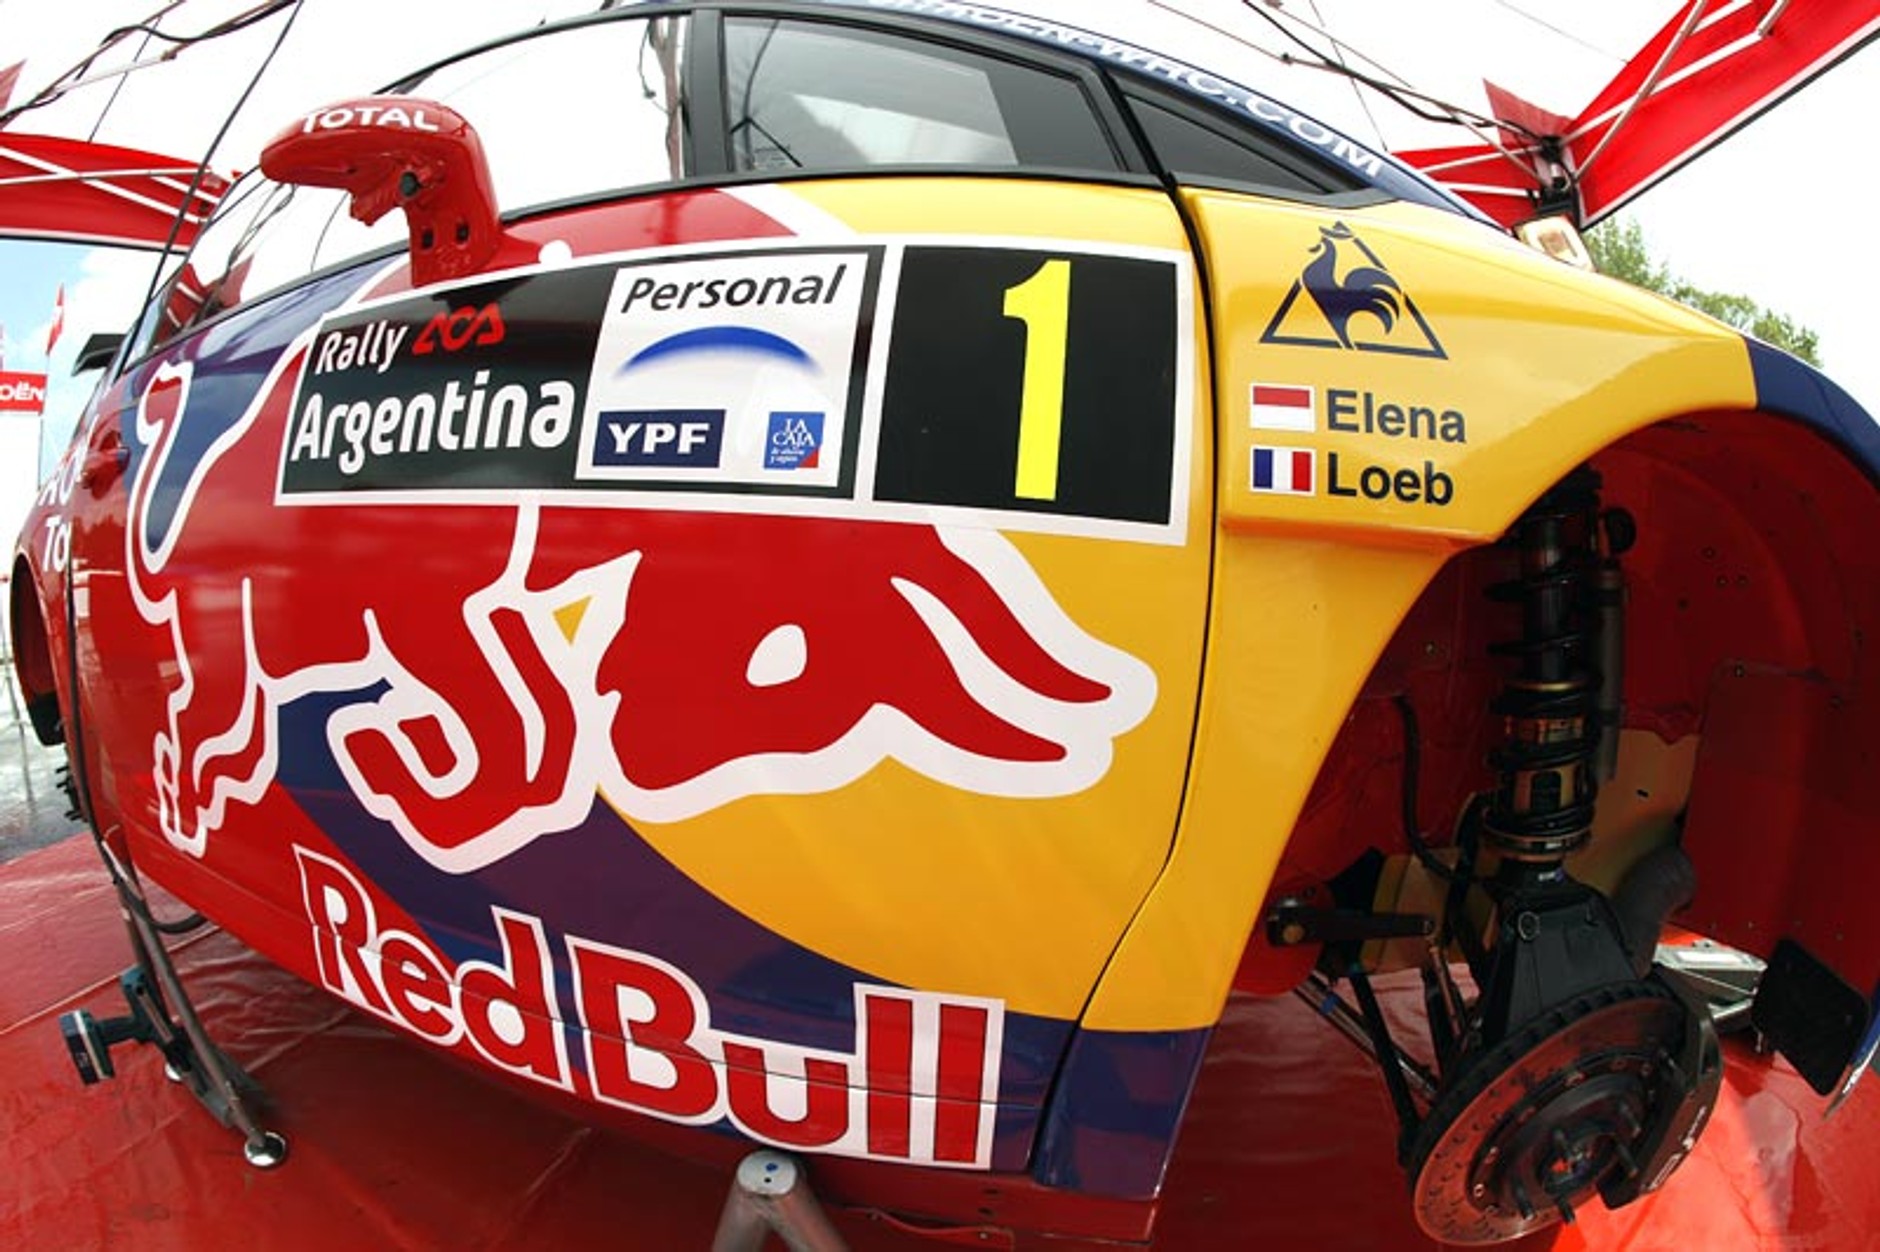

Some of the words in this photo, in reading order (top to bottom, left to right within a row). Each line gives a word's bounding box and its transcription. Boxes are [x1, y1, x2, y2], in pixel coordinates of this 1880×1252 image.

[303, 107, 439, 133] TOTAL
[621, 263, 847, 314] Personal
[315, 319, 409, 375] Rally
[1003, 259, 1070, 501] 1
[290, 369, 576, 475] Argentina
[608, 423, 710, 454] YPF
[785, 418, 807, 433] LA
[1326, 388, 1468, 443] Elena
[1327, 452, 1454, 506] Loeb
[293, 844, 576, 1092] Red
[564, 934, 1005, 1170] Bull
